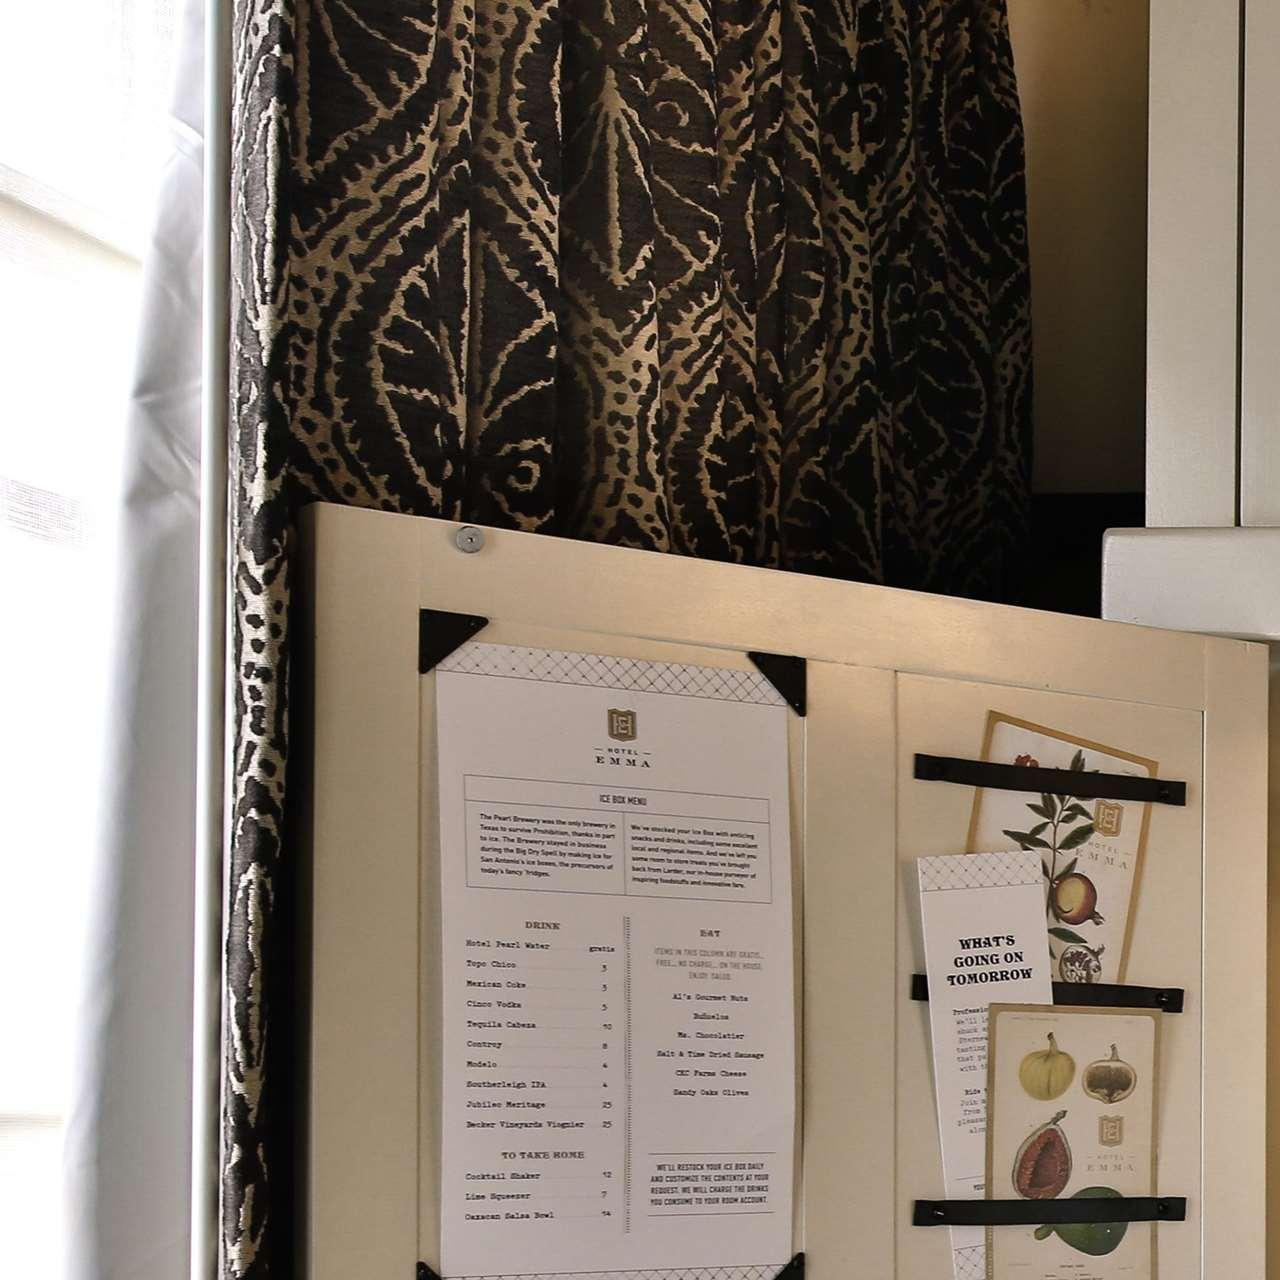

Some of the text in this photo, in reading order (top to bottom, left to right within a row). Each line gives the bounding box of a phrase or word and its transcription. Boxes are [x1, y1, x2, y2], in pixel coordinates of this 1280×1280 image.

[596, 756, 650, 768] EMMA
[600, 795, 647, 806] ICE BOX MENU
[525, 921, 560, 930] DRINK
[466, 939, 491, 947] Hotel
[496, 940, 521, 948] Pearl
[525, 942, 550, 950] Water
[959, 935, 1015, 950] WHAT'S
[954, 951, 1024, 968] GOING ON
[466, 960, 516, 968] Topo Chico
[947, 968, 1033, 986] TOMORROW
[466, 980, 502, 988] Mexican
[466, 1000, 522, 1008] Cinco Vodka
[466, 1021, 502, 1029] Tequila
[466, 1081, 527, 1089] Southerleigh
[466, 1121, 585, 1129] Becker Vineyards Viognier
[501, 1152, 585, 1160] TO TAKE HOME
[465, 1173, 505, 1181] Cocktail
